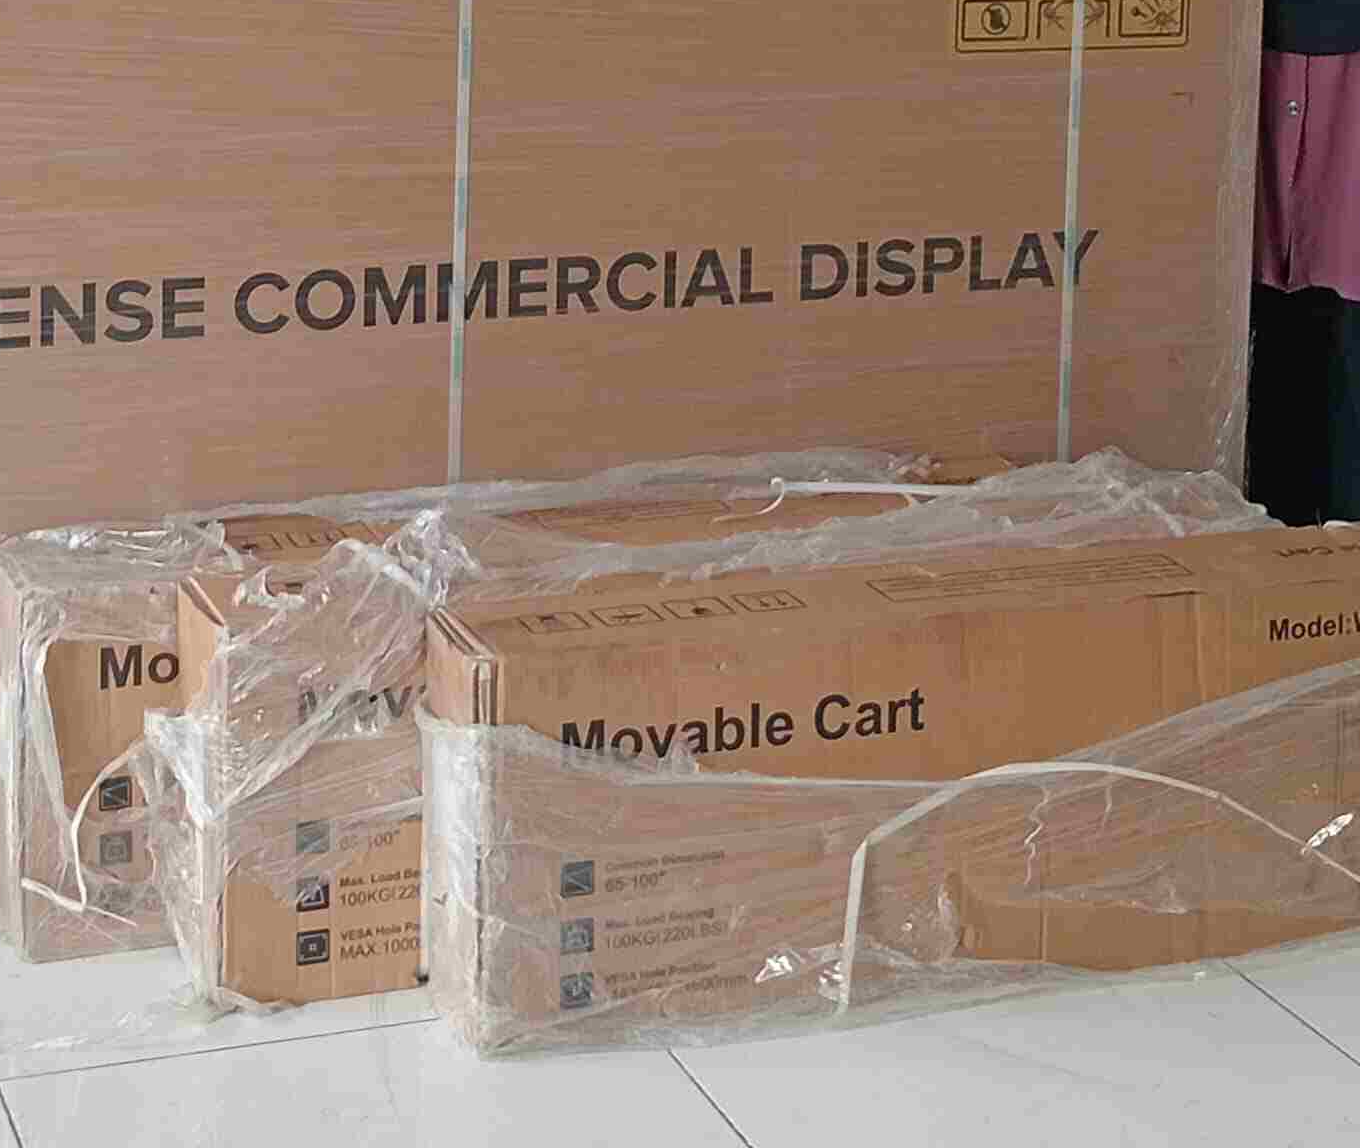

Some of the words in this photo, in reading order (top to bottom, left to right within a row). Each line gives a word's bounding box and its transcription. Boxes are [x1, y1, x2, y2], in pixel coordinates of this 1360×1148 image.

[233, 245, 775, 335] COMMERCIAL
[799, 228, 1101, 303] DISPLAY
[560, 702, 795, 761] Movable
[813, 687, 926, 742] Cart
